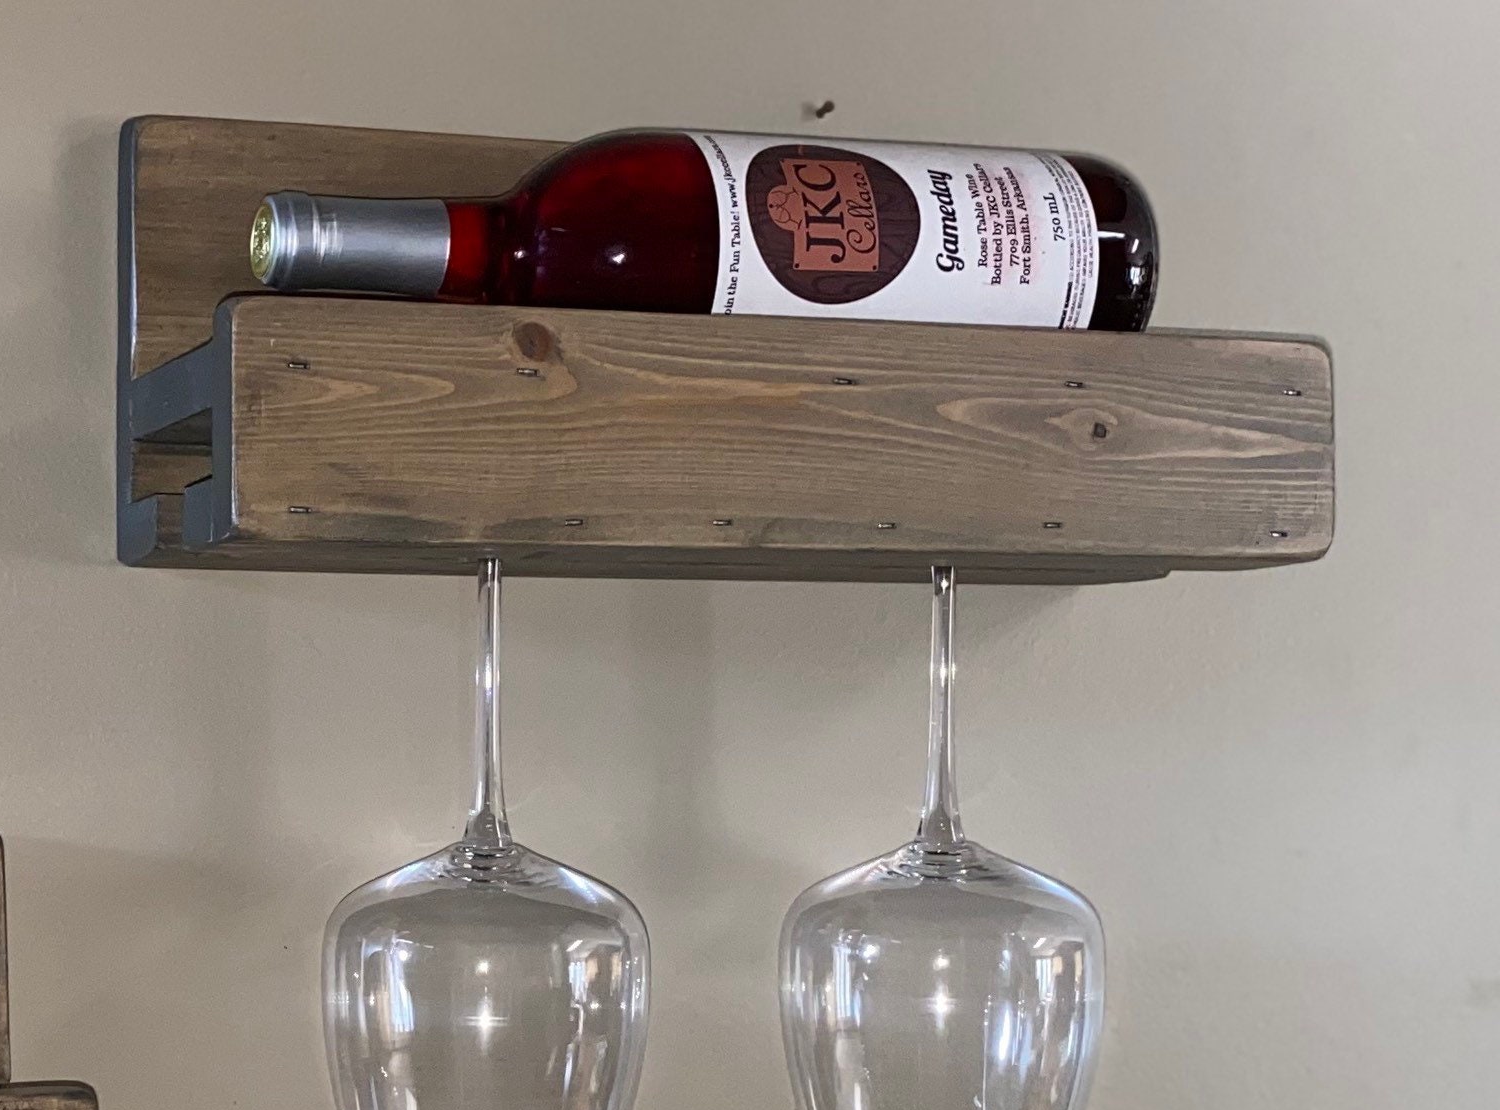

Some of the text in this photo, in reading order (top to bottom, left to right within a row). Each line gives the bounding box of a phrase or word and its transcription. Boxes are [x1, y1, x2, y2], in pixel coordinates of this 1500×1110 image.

[793, 164, 846, 263] JKC
[846, 172, 877, 253] Cellars
[1002, 166, 1027, 211] Arkansas
[730, 211, 741, 248] Table!
[927, 169, 965, 273] Gameday
[965, 173, 988, 268] Rose Table Wine
[972, 162, 1003, 285] Bottled by JKC Cellars
[993, 176, 1020, 267] 7709 Ellis Street
[1042, 192, 1066, 242] 750 mL
[724, 276, 739, 296] the
[729, 250, 741, 273] Fun
[1019, 257, 1031, 285] Fort
[723, 297, 735, 315] oin
